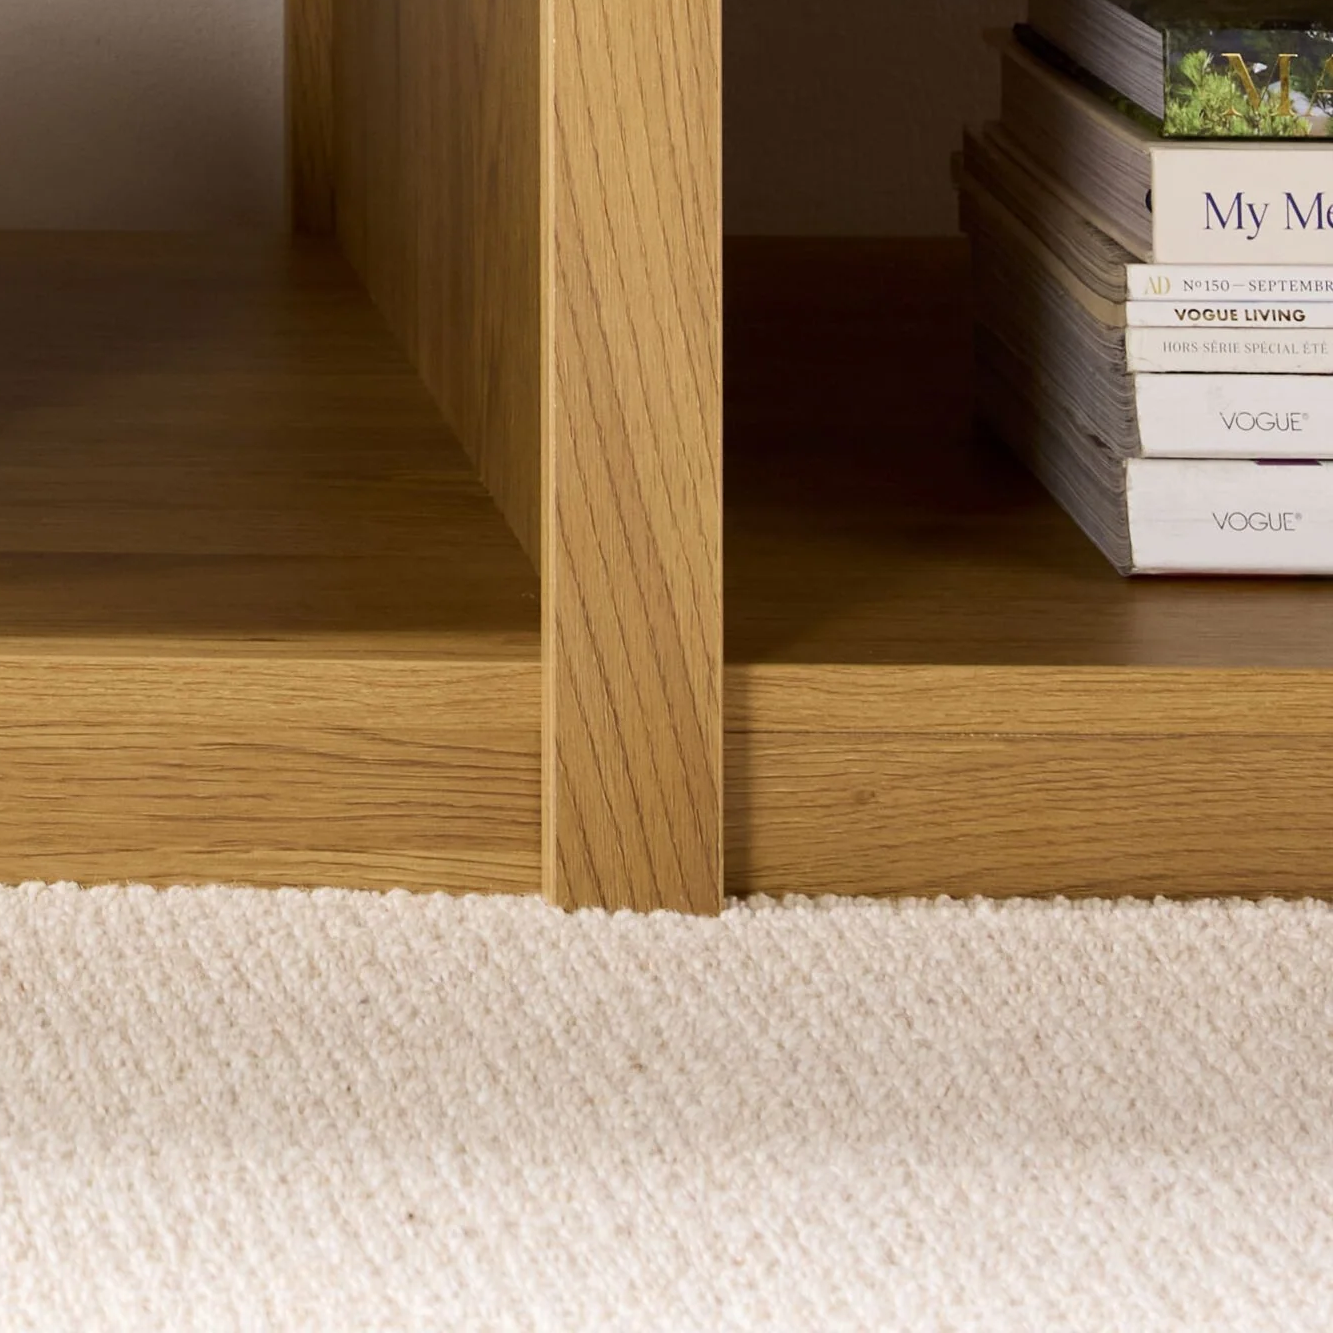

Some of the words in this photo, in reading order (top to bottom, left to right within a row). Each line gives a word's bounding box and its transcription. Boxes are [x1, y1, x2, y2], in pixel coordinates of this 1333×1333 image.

[1203, 192, 1269, 241] My
[1144, 276, 1172, 295] AD
[1174, 308, 1238, 322] VOGUE
[1244, 308, 1306, 322] LIVING
[1163, 341, 1199, 354] HORS
[1244, 340, 1300, 355] SPÉCIAL
